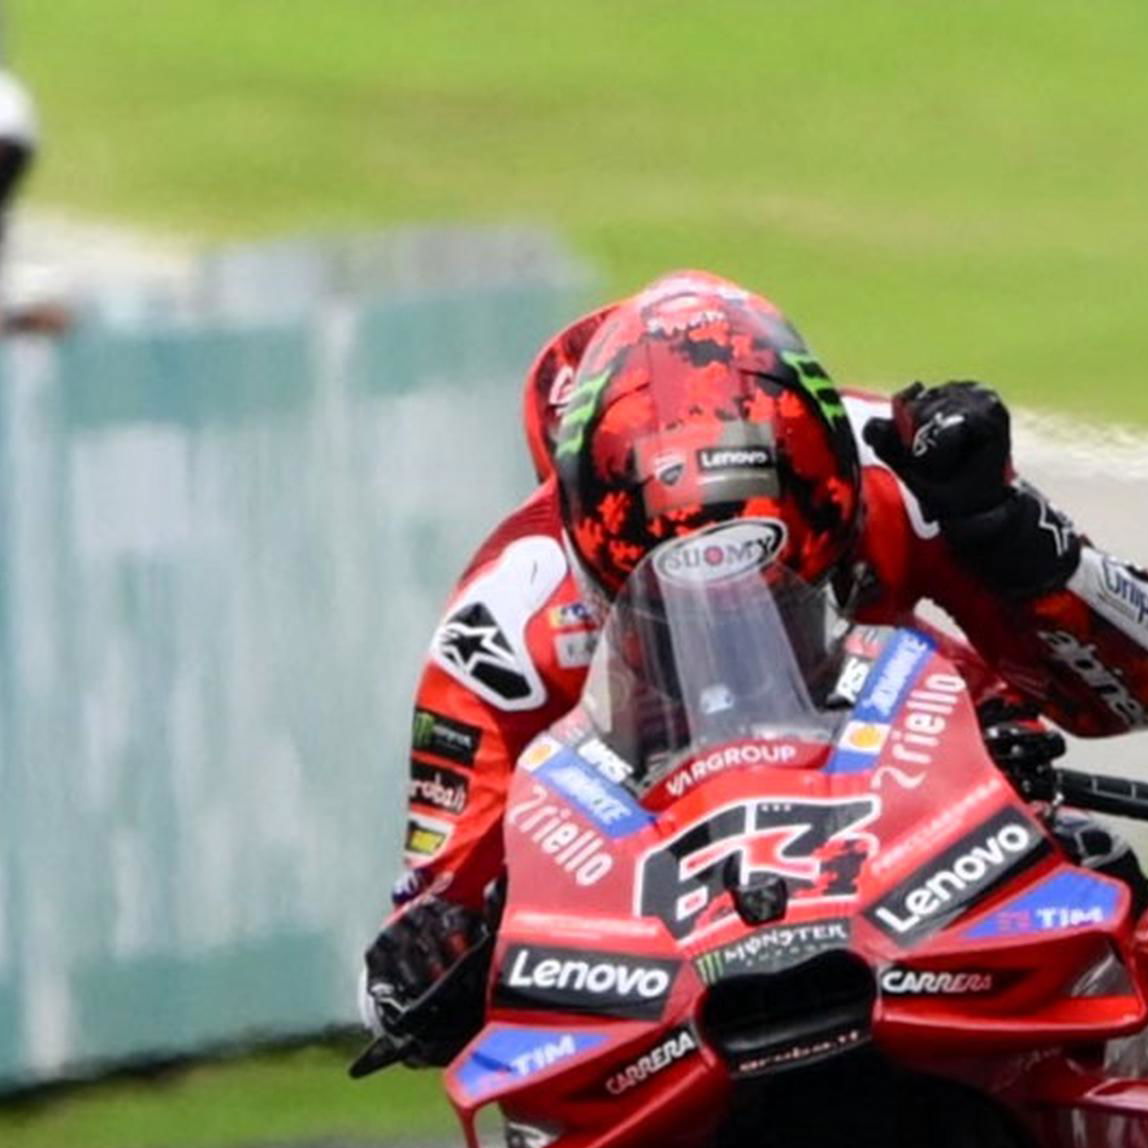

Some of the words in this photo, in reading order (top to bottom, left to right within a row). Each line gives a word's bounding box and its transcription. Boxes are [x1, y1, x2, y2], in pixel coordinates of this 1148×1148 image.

[701, 450, 769, 468] Lenovo
[876, 823, 1031, 933] Lenovo
[1036, 906, 1104, 928] TIM
[723, 923, 847, 963] MONSTER
[509, 949, 669, 998] Lenovo
[509, 1034, 577, 1076] TIM
[605, 1031, 697, 1095] CARRERA
